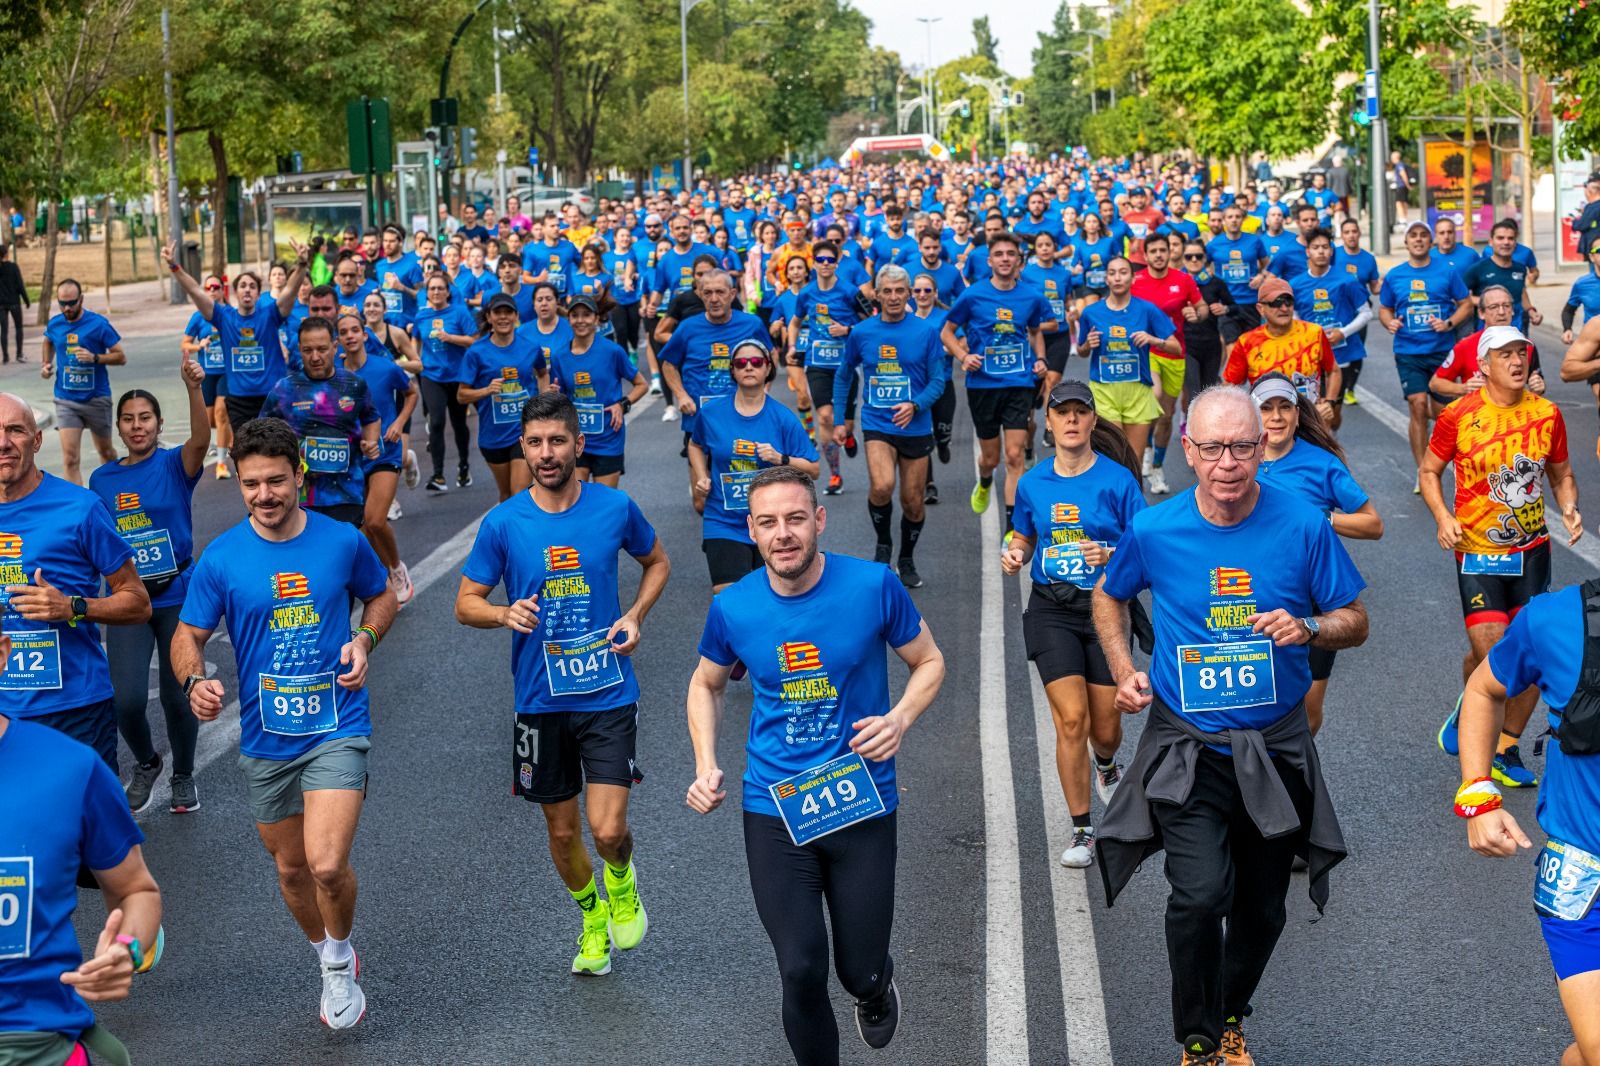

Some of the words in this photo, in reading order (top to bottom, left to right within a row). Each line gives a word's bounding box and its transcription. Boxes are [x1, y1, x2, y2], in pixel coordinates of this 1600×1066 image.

[238, 355, 258, 364] 423
[818, 349, 839, 358] 458
[993, 354, 1016, 364] 133
[1108, 364, 1132, 374] 158
[69, 374, 88, 382] 284
[877, 386, 902, 398] 077
[500, 401, 524, 414] 835
[578, 414, 594, 424] 31
[308, 449, 346, 462] 4099
[732, 484, 750, 498] 25
[273, 604, 314, 619] MUÉVETE
[1210, 604, 1256, 618] MUÉVETE
[269, 620, 276, 630] X
[278, 613, 320, 629] VALENCIA
[1205, 618, 1212, 628] X
[1214, 616, 1250, 628] VALEN
[4, 651, 44, 671] 12
[555, 648, 608, 676] 1047
[1238, 652, 1268, 662] VALENCIA
[783, 677, 829, 692] MUÉVETE
[1199, 665, 1256, 690] 816
[274, 695, 320, 716] 938
[516, 722, 538, 765] 31
[799, 776, 827, 792] MUÉVETE
[832, 762, 861, 779] VALENCIA
[801, 780, 857, 815] 419
[798, 818, 820, 831] MIGUEL
[822, 810, 840, 820] ANGEL
[842, 797, 871, 812] NOGUERA
